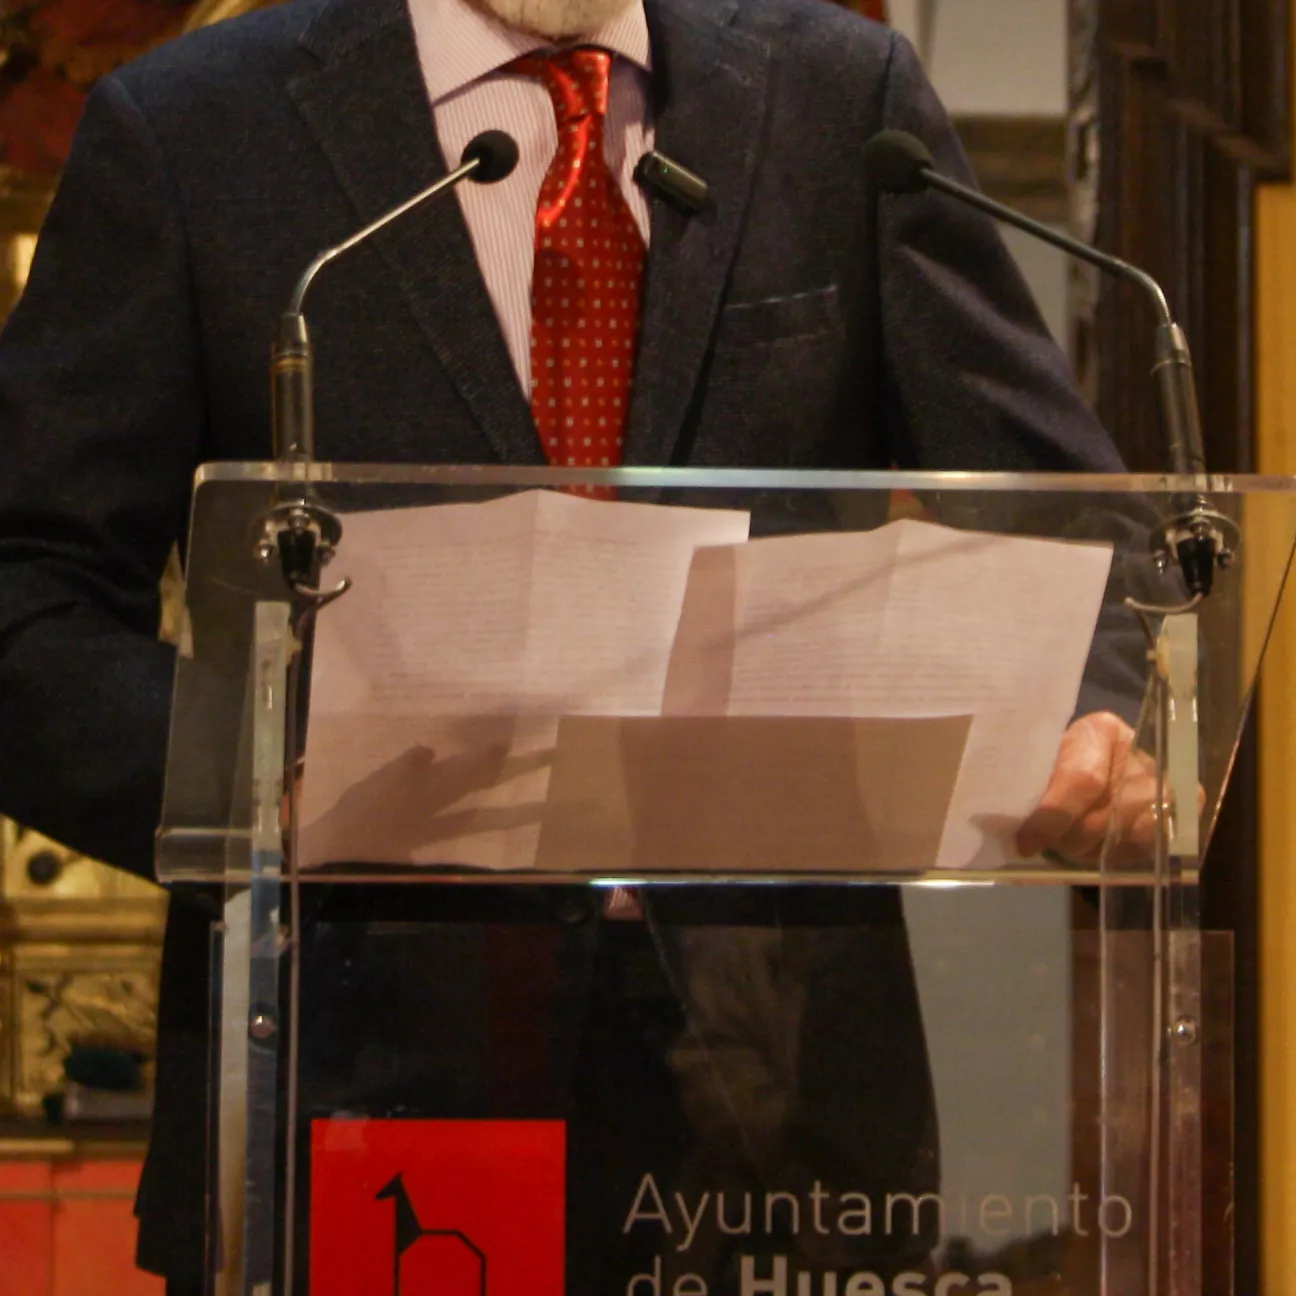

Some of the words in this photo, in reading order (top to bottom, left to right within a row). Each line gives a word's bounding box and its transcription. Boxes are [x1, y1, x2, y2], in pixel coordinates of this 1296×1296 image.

[623, 1173, 1133, 1250] Ayuntamiento
[626, 1255, 708, 1296] de
[740, 1255, 1014, 1296] Huesca
